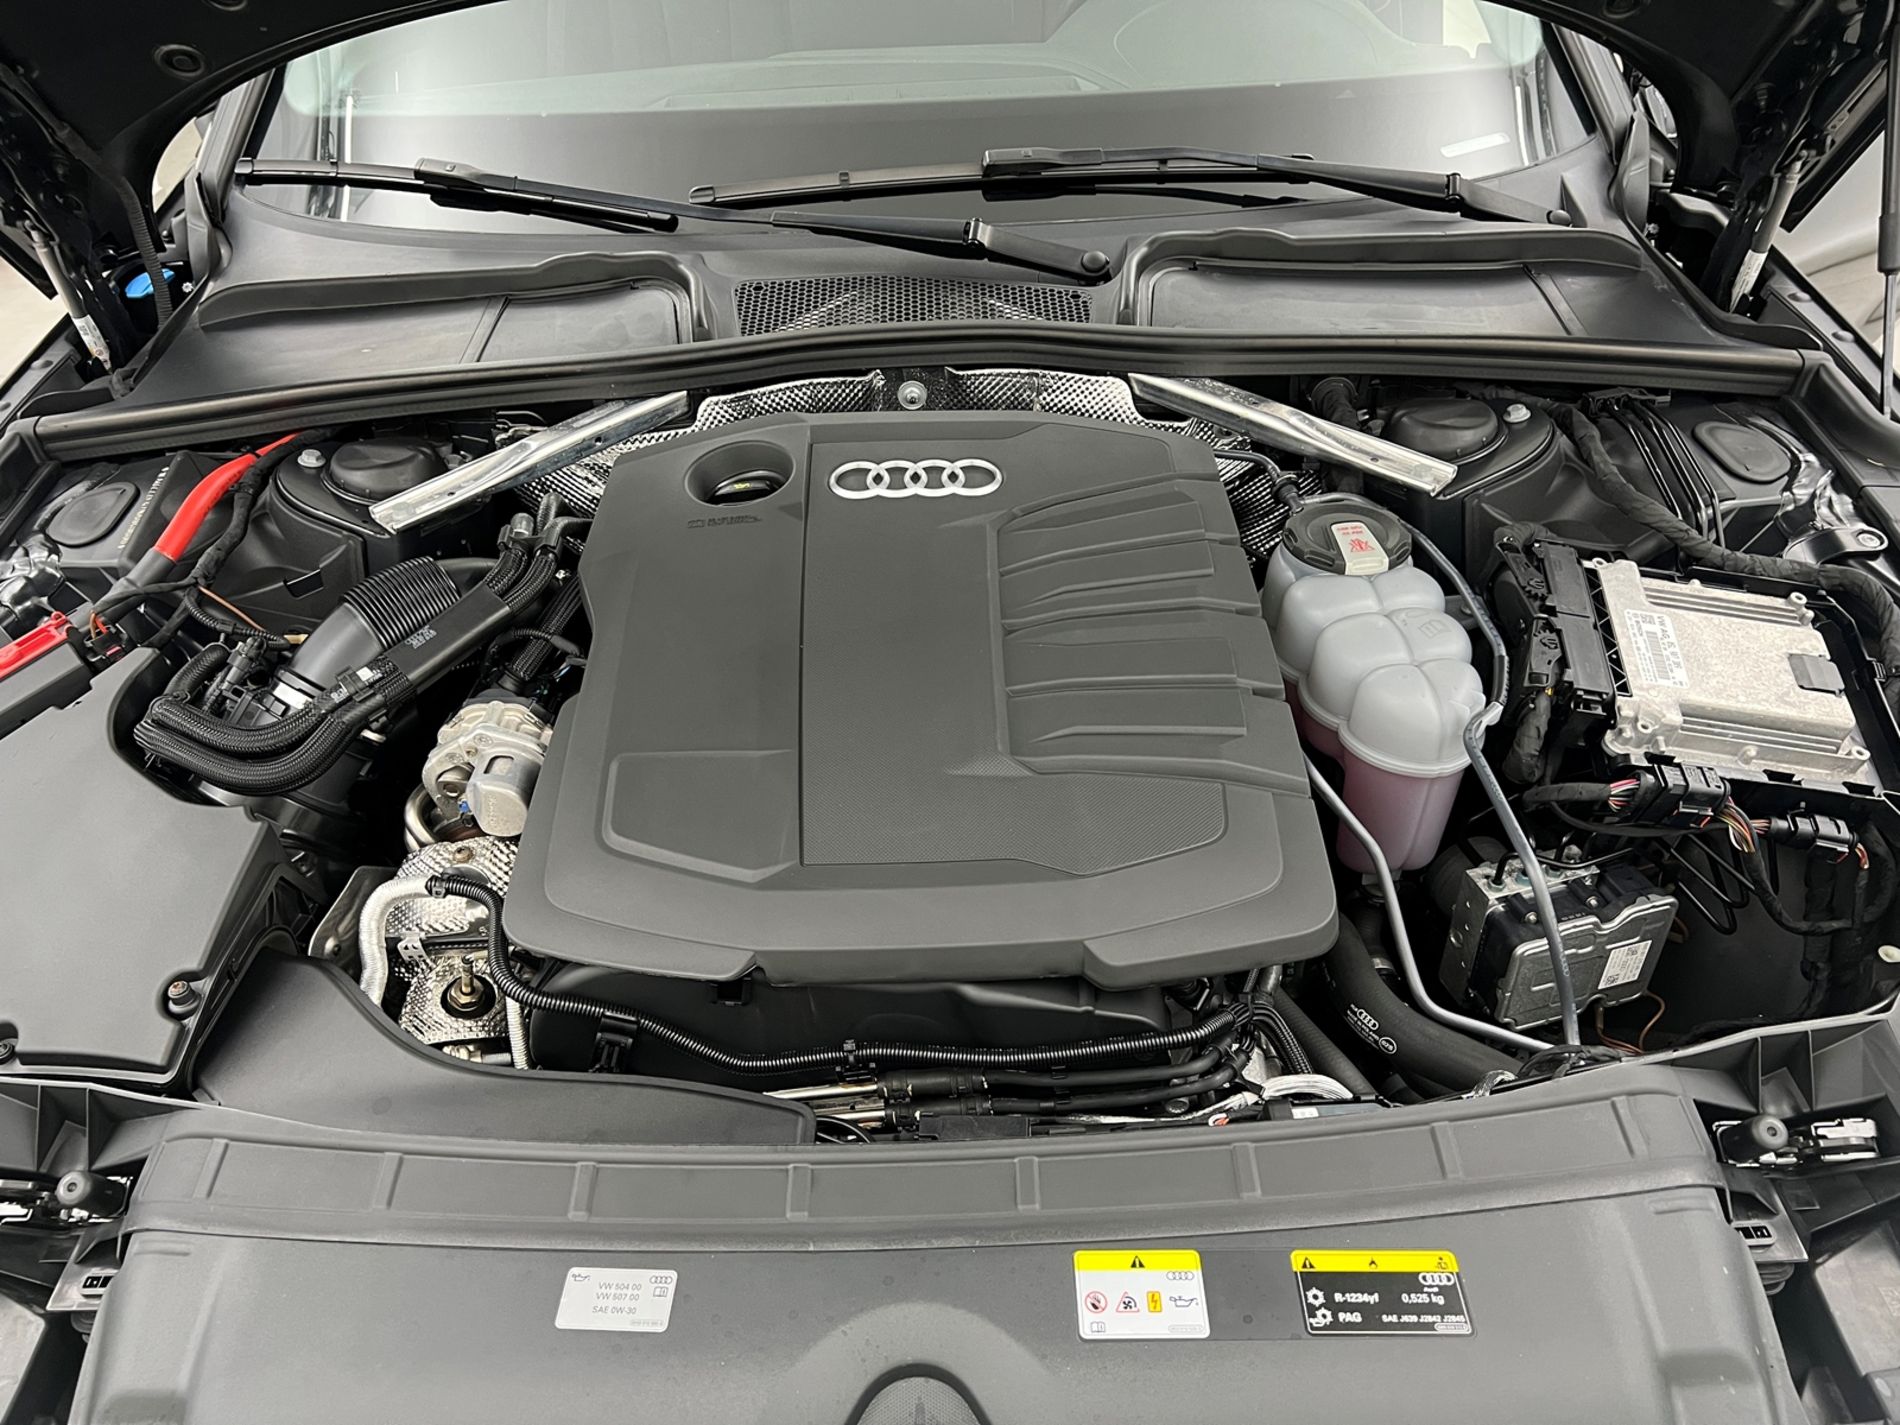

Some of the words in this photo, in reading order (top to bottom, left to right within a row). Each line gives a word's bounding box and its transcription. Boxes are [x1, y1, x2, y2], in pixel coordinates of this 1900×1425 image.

[599, 1282, 614, 1291] VW
[615, 1283, 630, 1291] 504
[631, 1283, 642, 1292] 00
[596, 1292, 611, 1301] VW
[612, 1292, 628, 1301] 507
[629, 1293, 640, 1302] 00
[1334, 1292, 1380, 1305] R-1234yf
[1401, 1292, 1431, 1305] 0,525
[1431, 1292, 1446, 1306] kg
[592, 1305, 609, 1314] SAE
[611, 1306, 637, 1315] 0W-30
[1338, 1311, 1363, 1323] PAG
